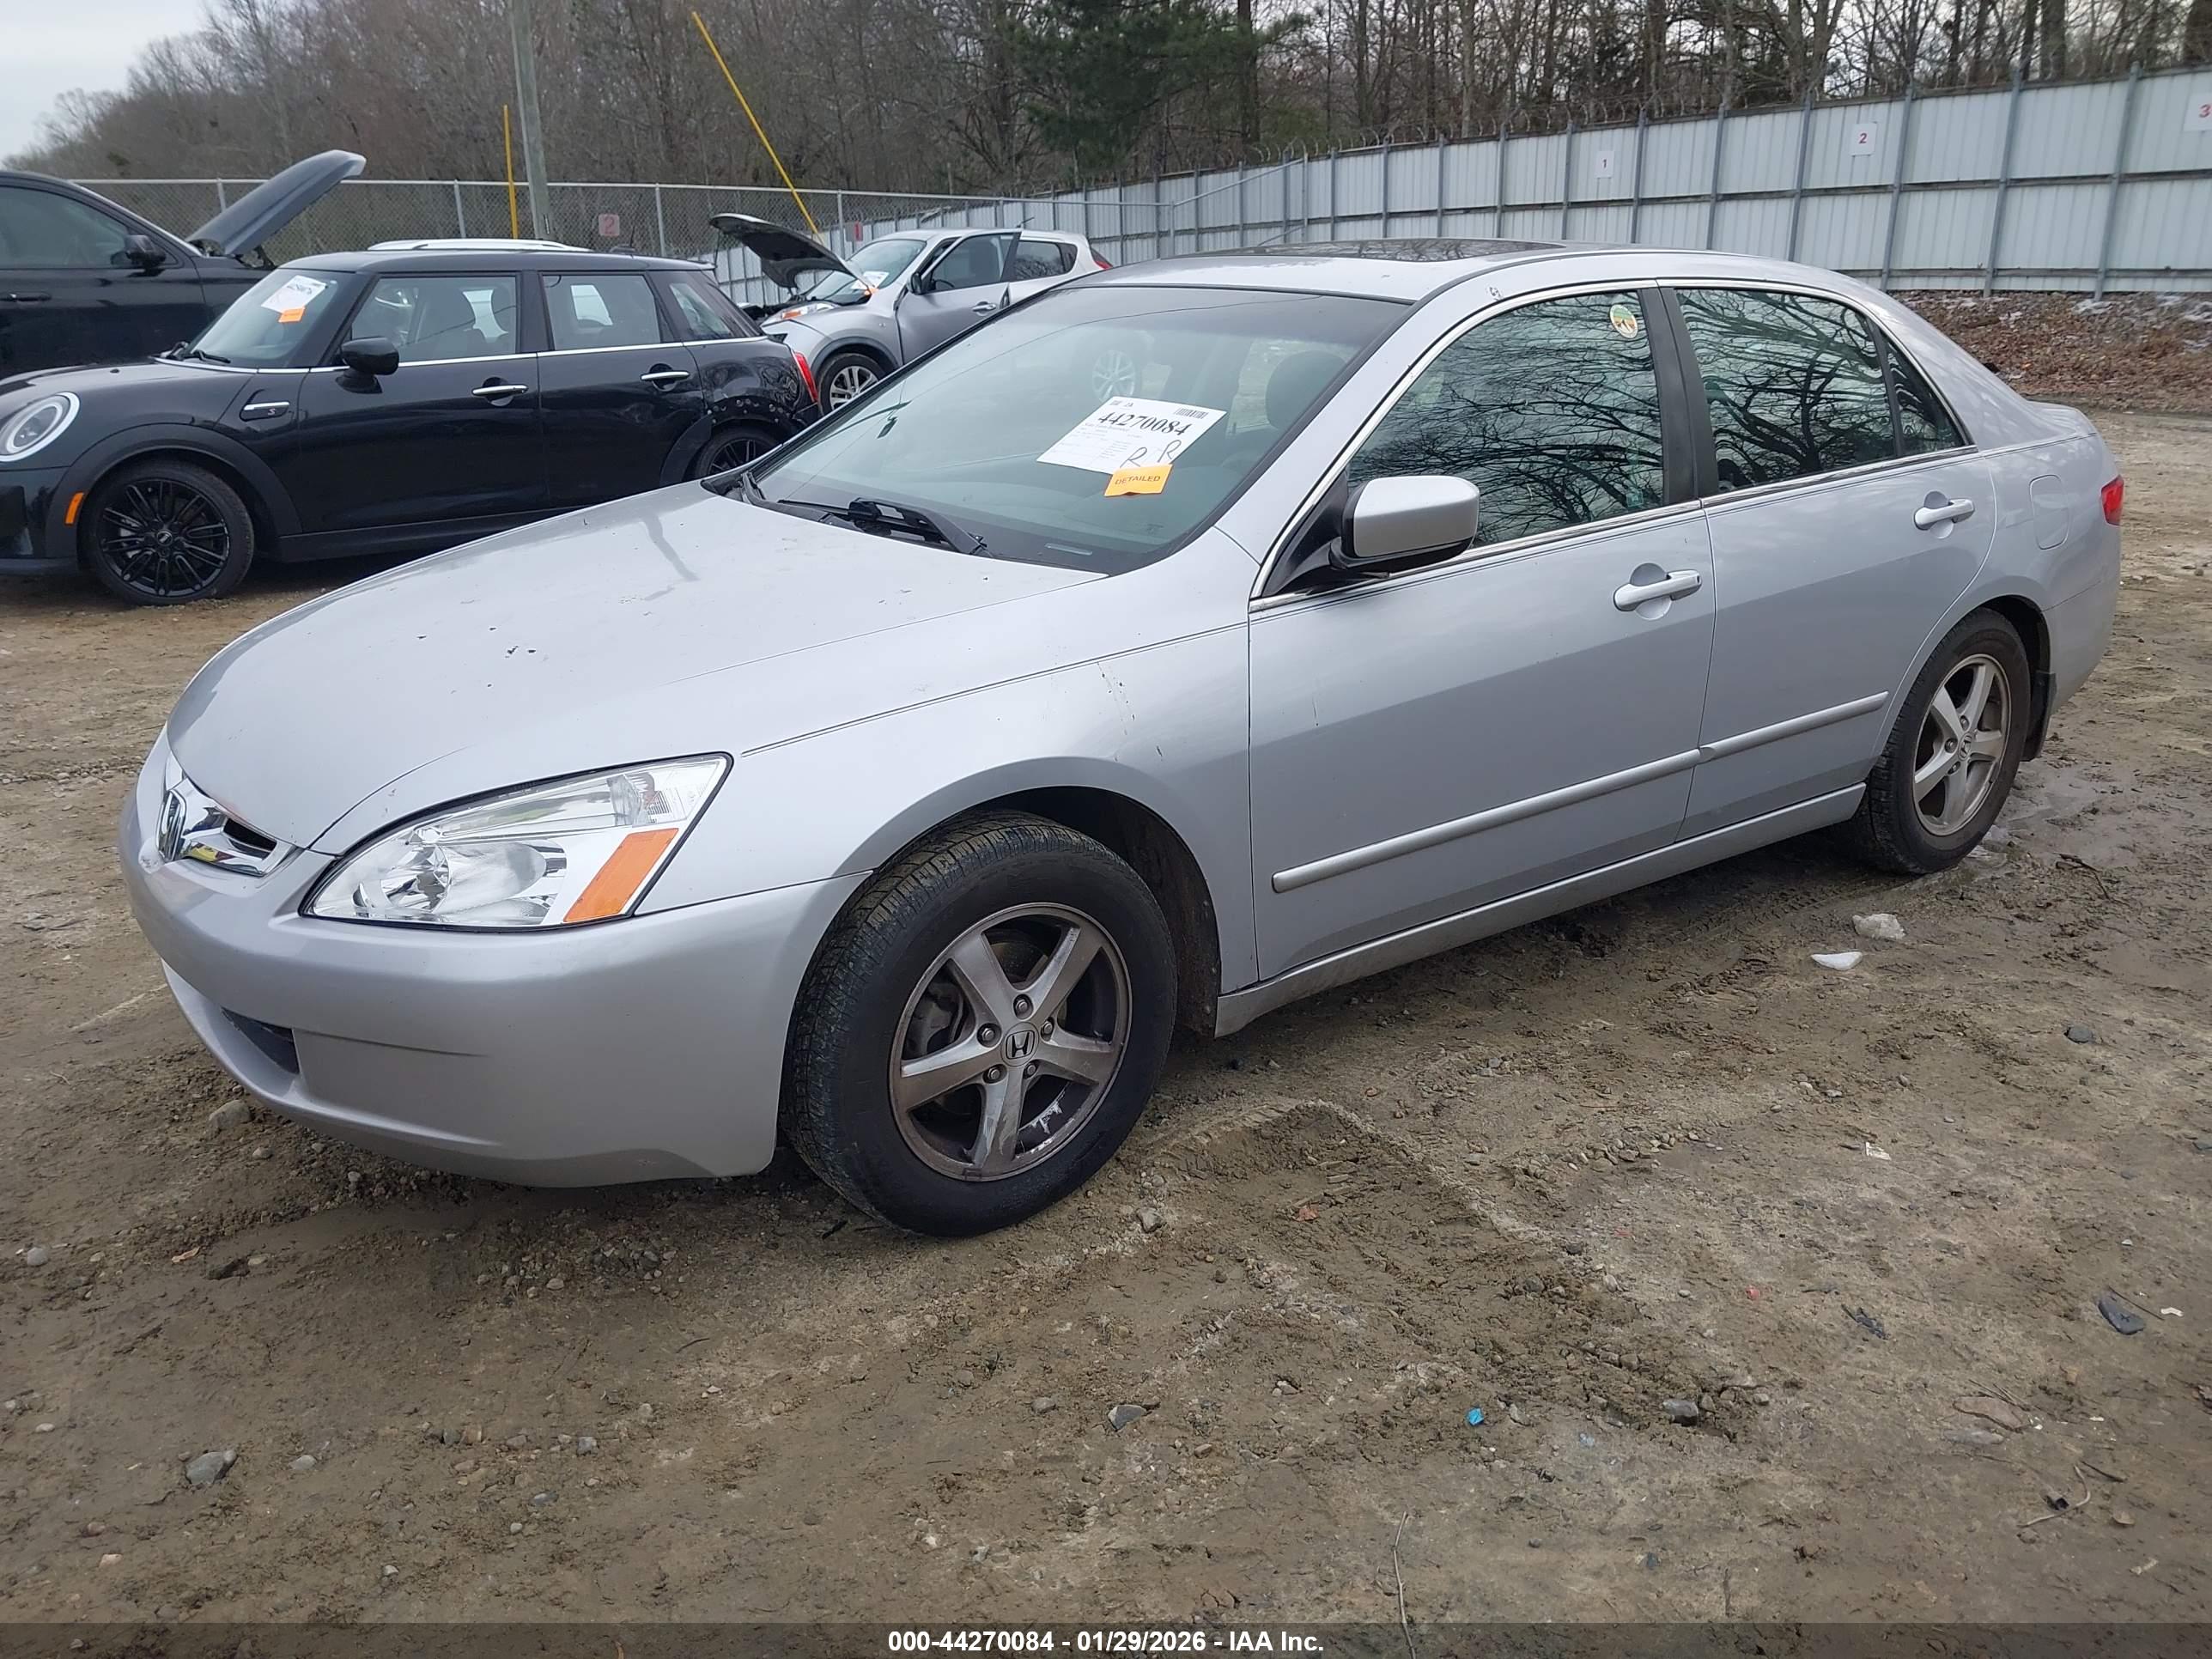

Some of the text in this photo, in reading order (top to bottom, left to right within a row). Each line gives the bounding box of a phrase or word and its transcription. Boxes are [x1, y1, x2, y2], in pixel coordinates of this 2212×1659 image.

[2198, 103, 2211, 118] 3
[1858, 132, 1868, 144] 2
[1097, 411, 1193, 436] 44270084
[1119, 447, 1147, 468] R
[1157, 439, 1182, 463] R
[1115, 475, 1161, 485] DETAILED
